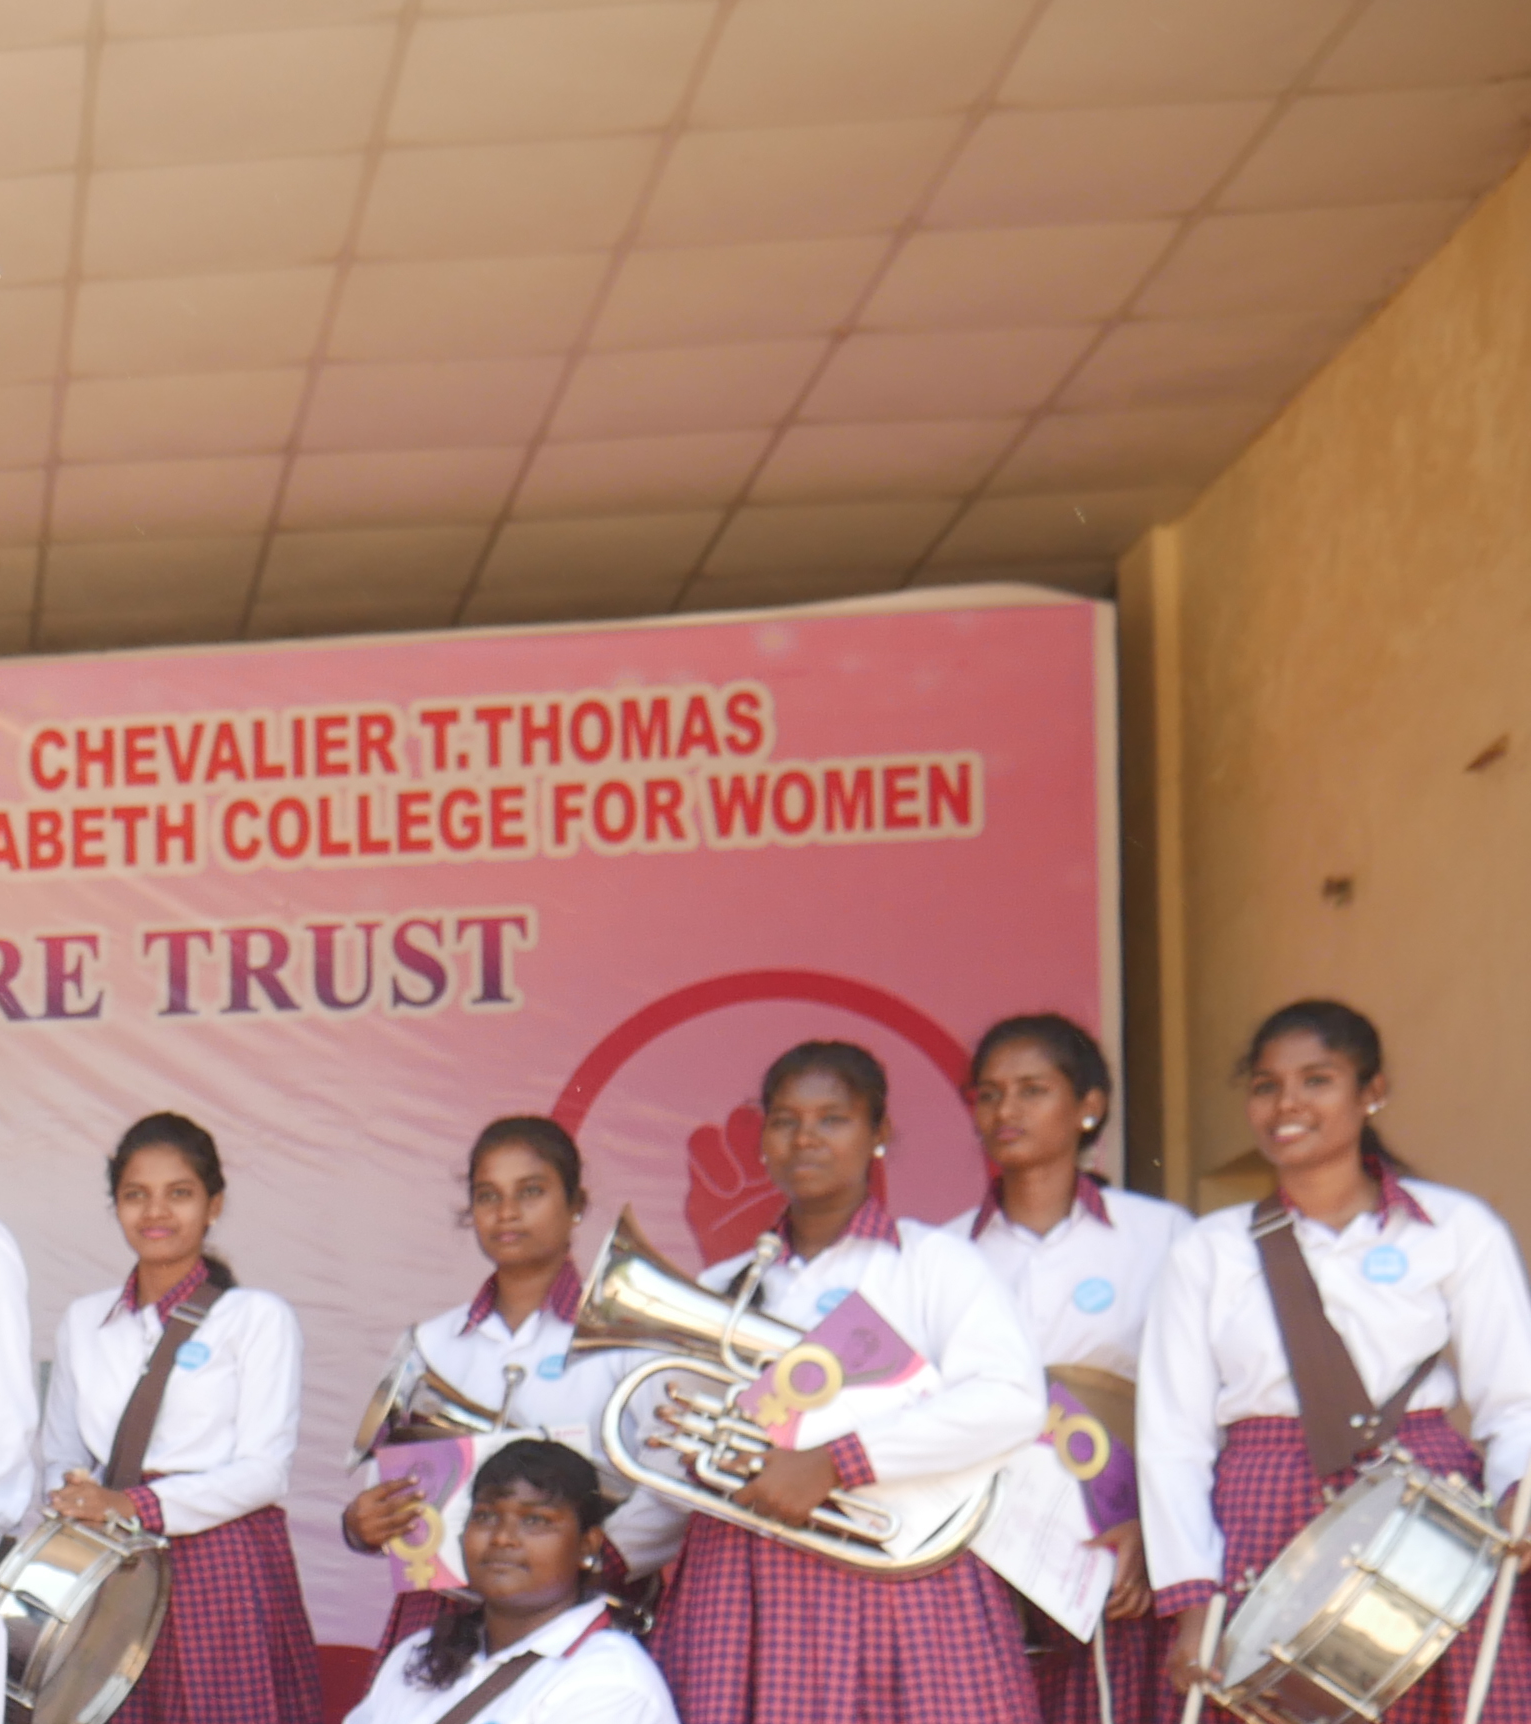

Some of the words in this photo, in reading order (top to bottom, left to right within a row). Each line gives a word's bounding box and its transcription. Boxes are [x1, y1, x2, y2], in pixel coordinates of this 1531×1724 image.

[30, 713, 399, 791] CHEVALIER
[420, 691, 764, 771] T.THOMAS
[222, 785, 527, 862] COLLEGE
[553, 778, 686, 846] FOR
[709, 761, 973, 838] WOMEN
[143, 915, 530, 1016] TRUST
